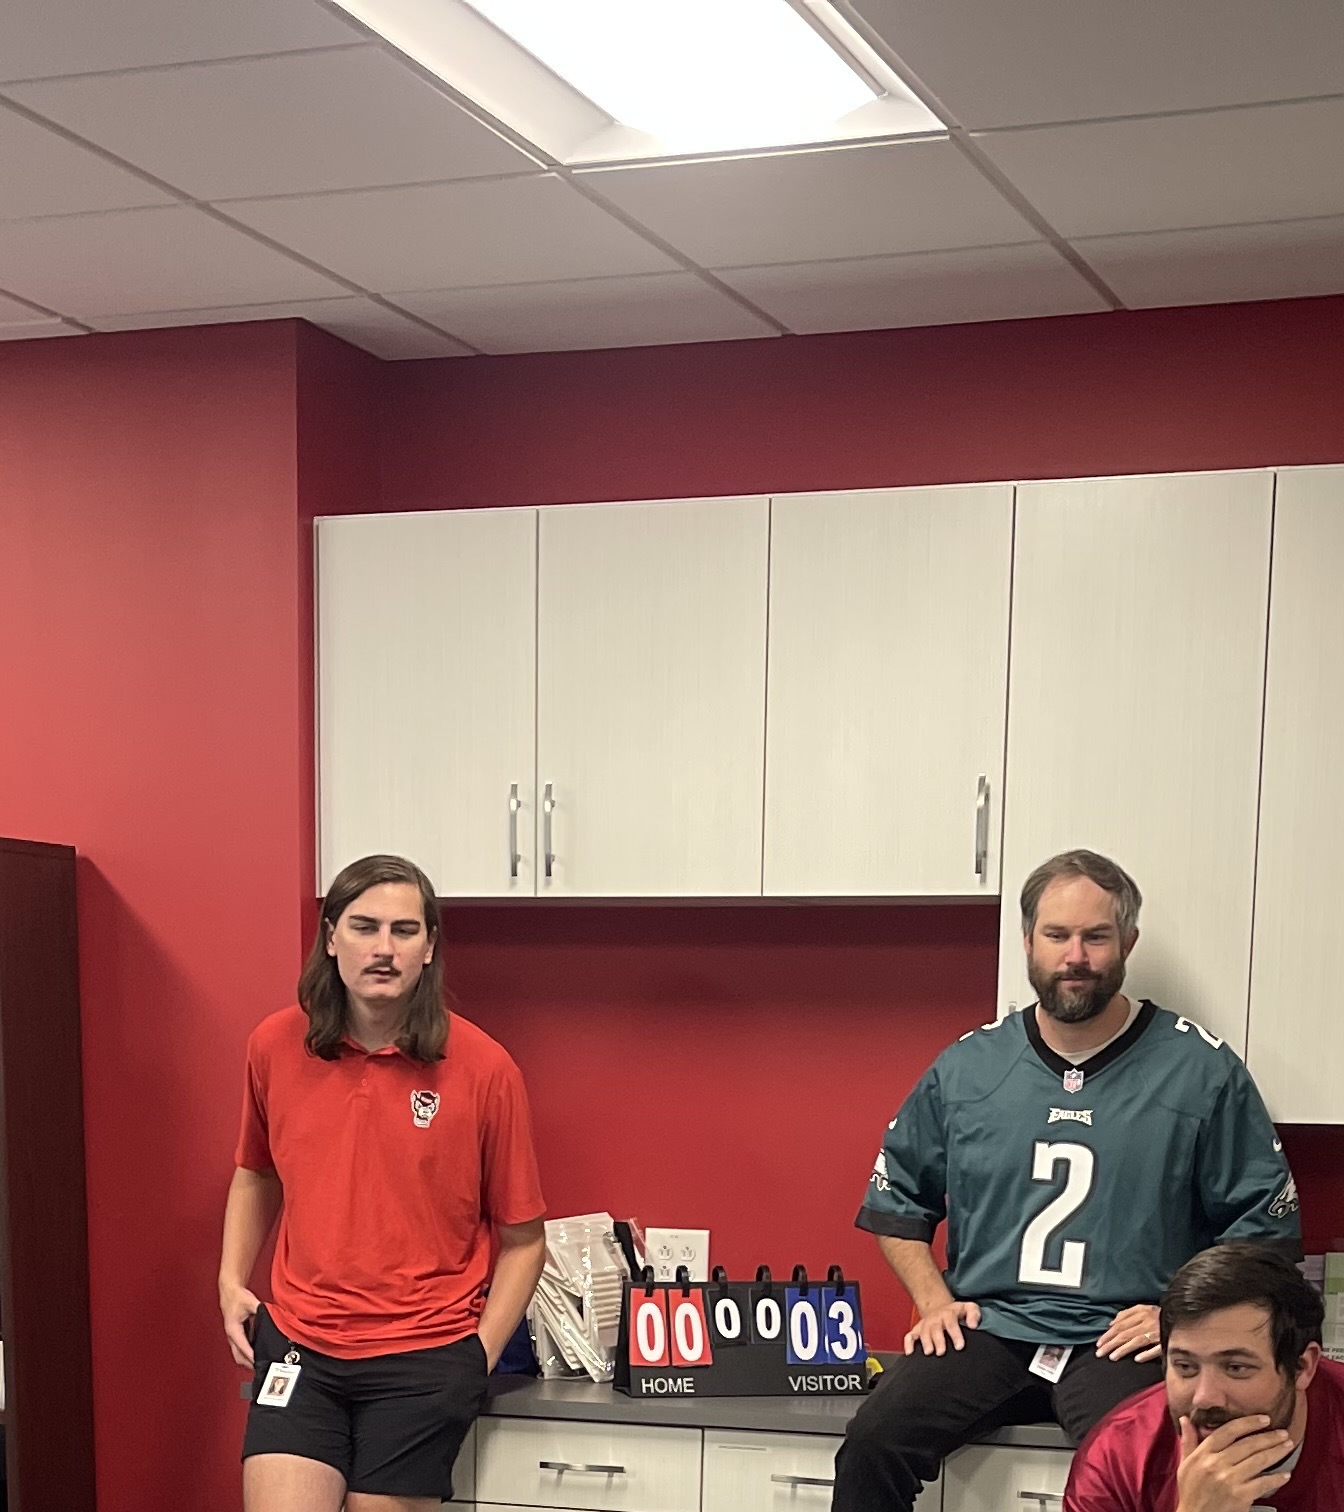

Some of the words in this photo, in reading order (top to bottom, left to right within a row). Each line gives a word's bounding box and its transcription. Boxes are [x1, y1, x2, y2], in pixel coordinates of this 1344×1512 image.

[1017, 1139, 1095, 1289] 2
[642, 1377, 696, 1393] HOME
[788, 1375, 861, 1392] VISITOR
